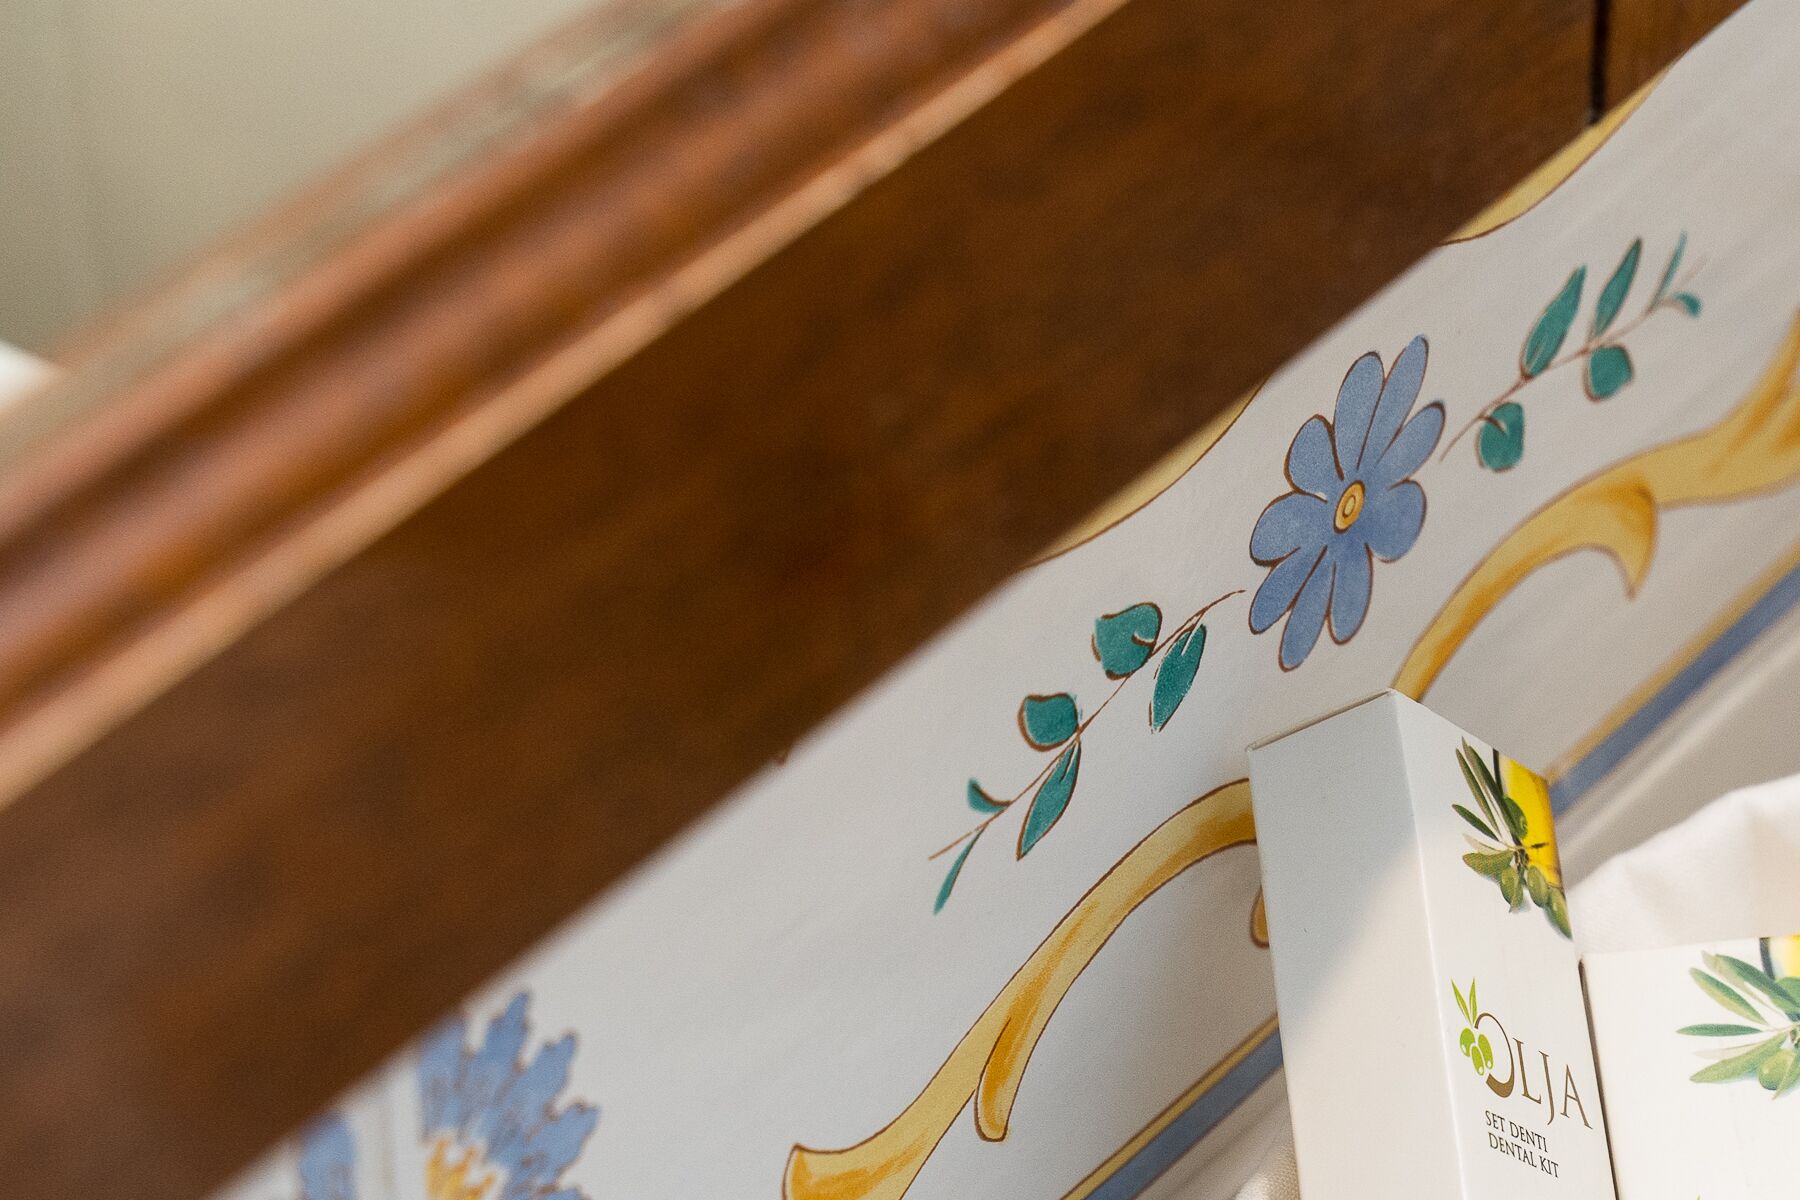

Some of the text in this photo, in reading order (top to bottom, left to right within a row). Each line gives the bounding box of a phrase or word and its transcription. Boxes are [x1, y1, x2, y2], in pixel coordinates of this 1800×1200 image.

[1474, 1012, 1593, 1130] OLJA
[1485, 1110, 1548, 1153] SET DENTI
[1488, 1131, 1559, 1178] DENTAL KIT
